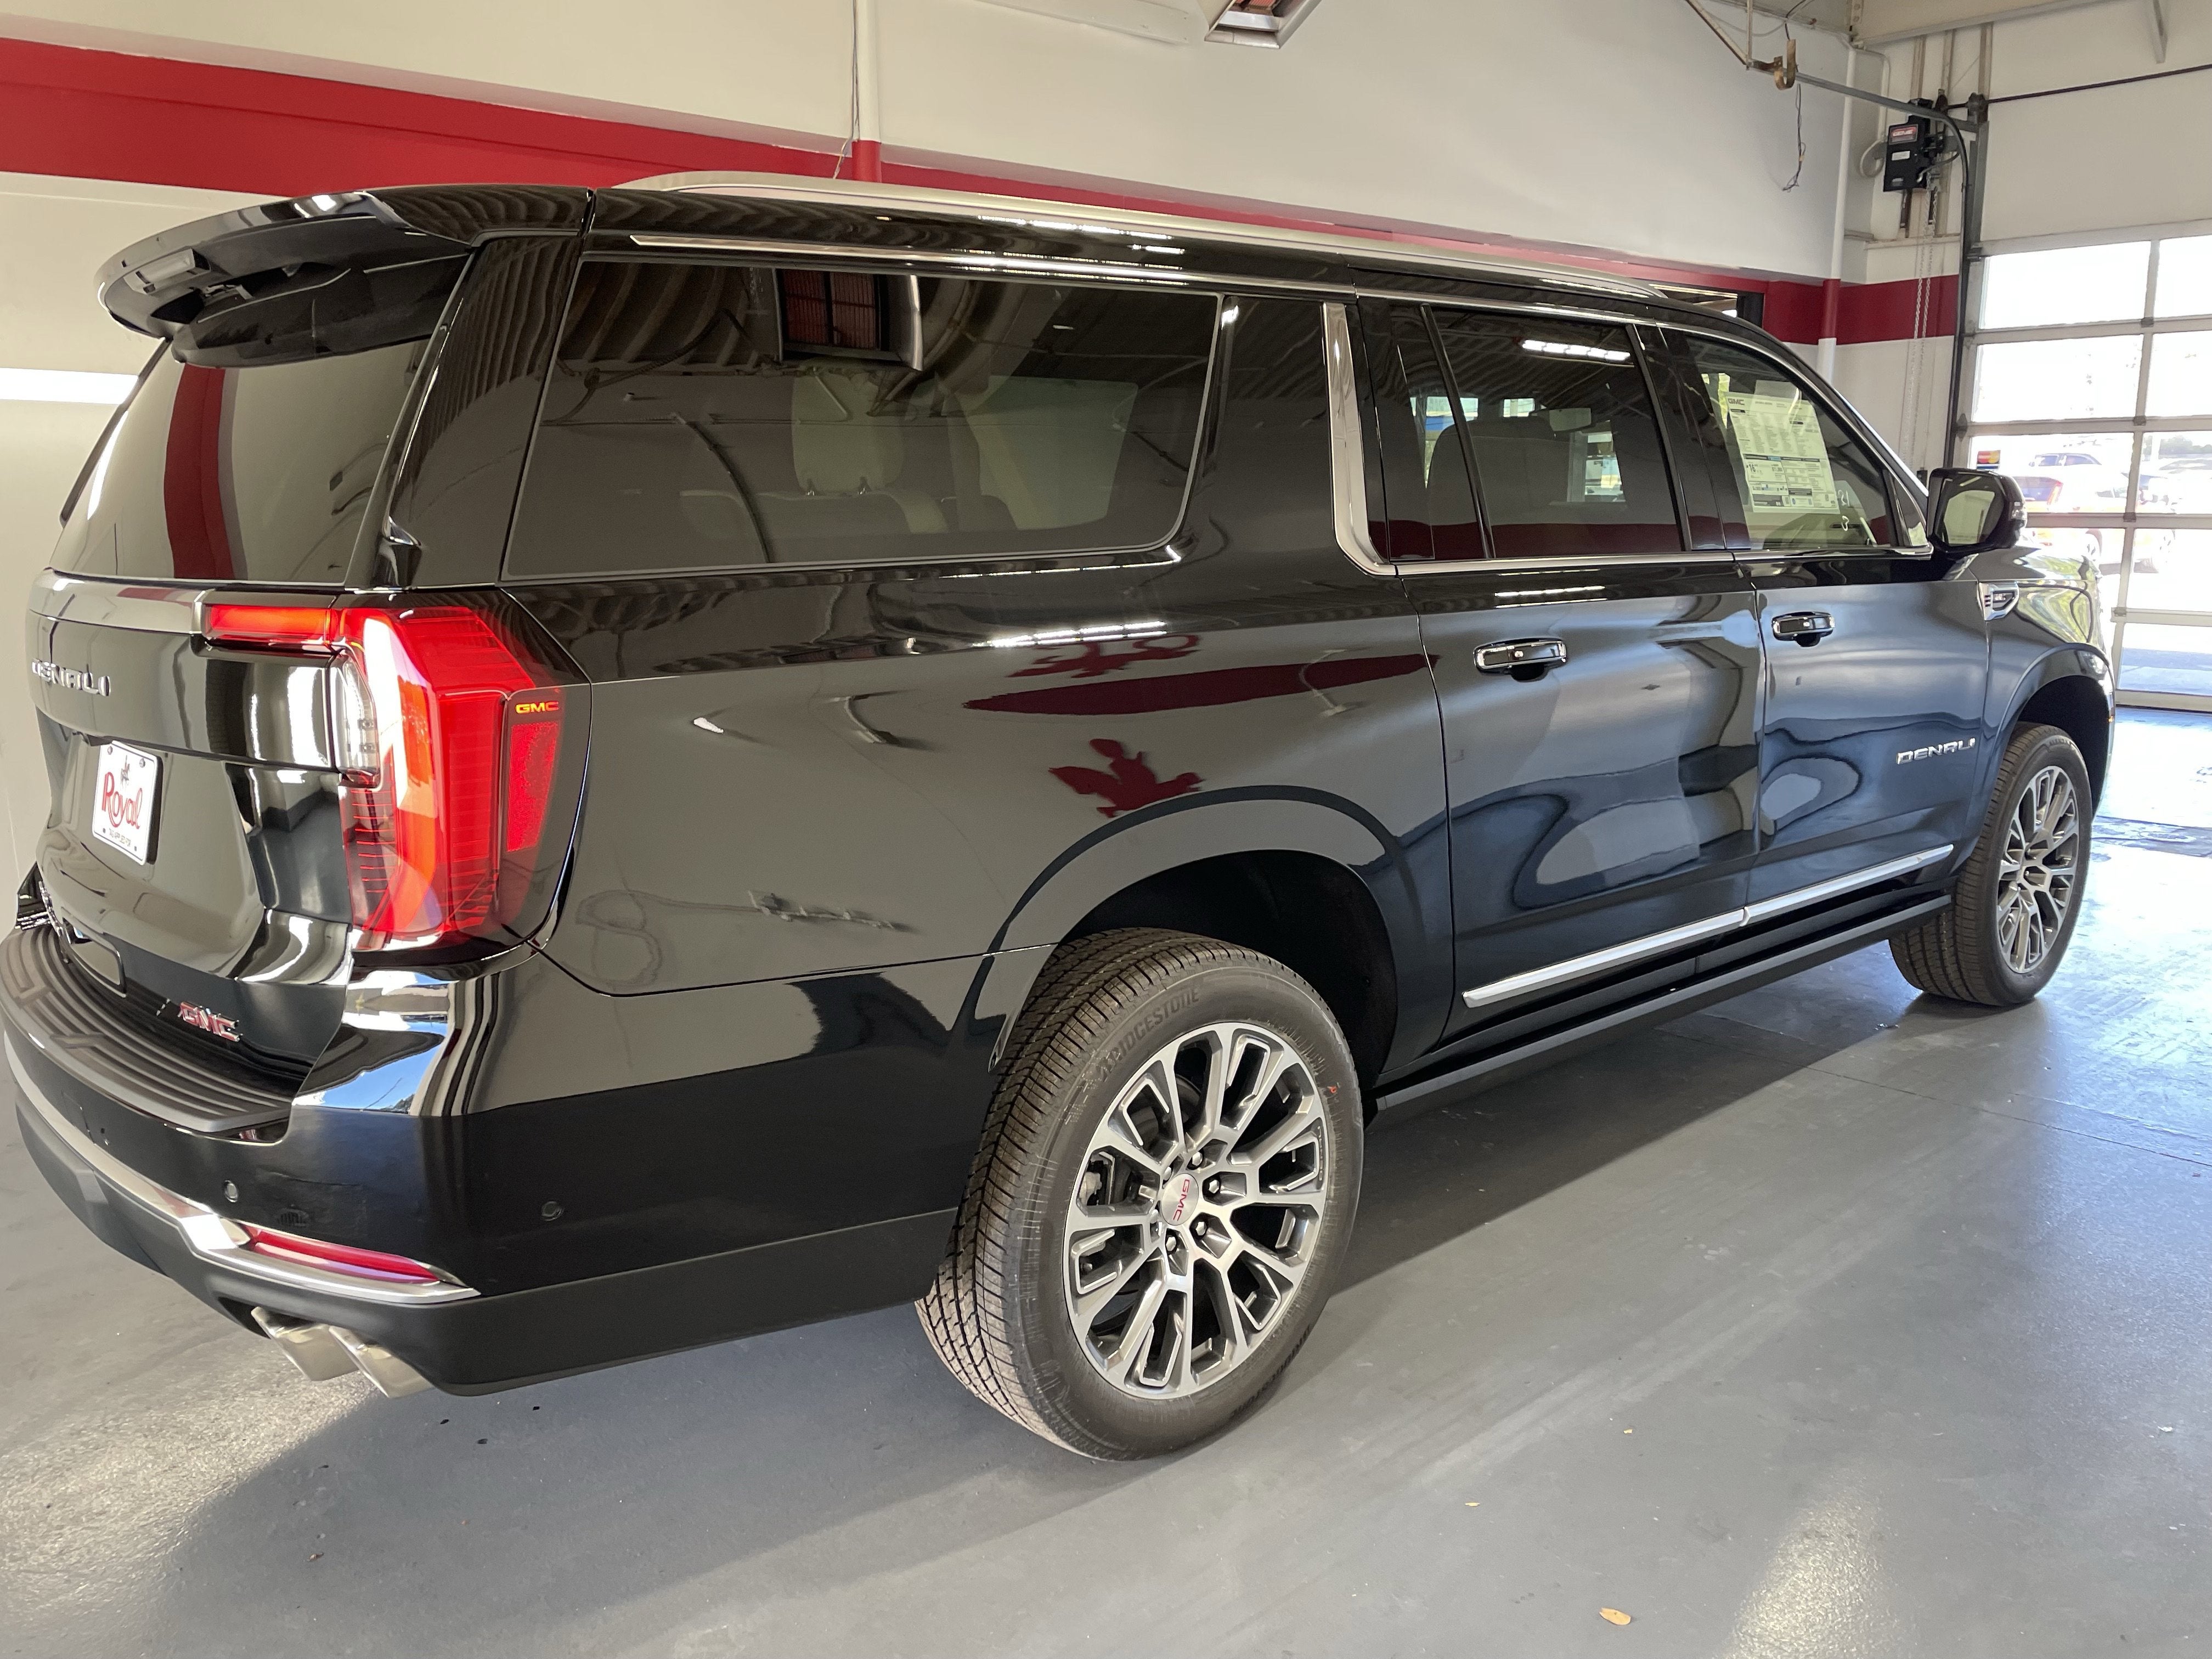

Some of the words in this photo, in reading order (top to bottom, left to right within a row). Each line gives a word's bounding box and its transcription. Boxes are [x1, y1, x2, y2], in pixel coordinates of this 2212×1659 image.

[515, 700, 559, 714] GMC
[1896, 737, 1976, 765] DENALI
[101, 771, 143, 830] Royal
[180, 1002, 240, 1042] GMC
[1173, 1179, 1190, 1221] GMC
